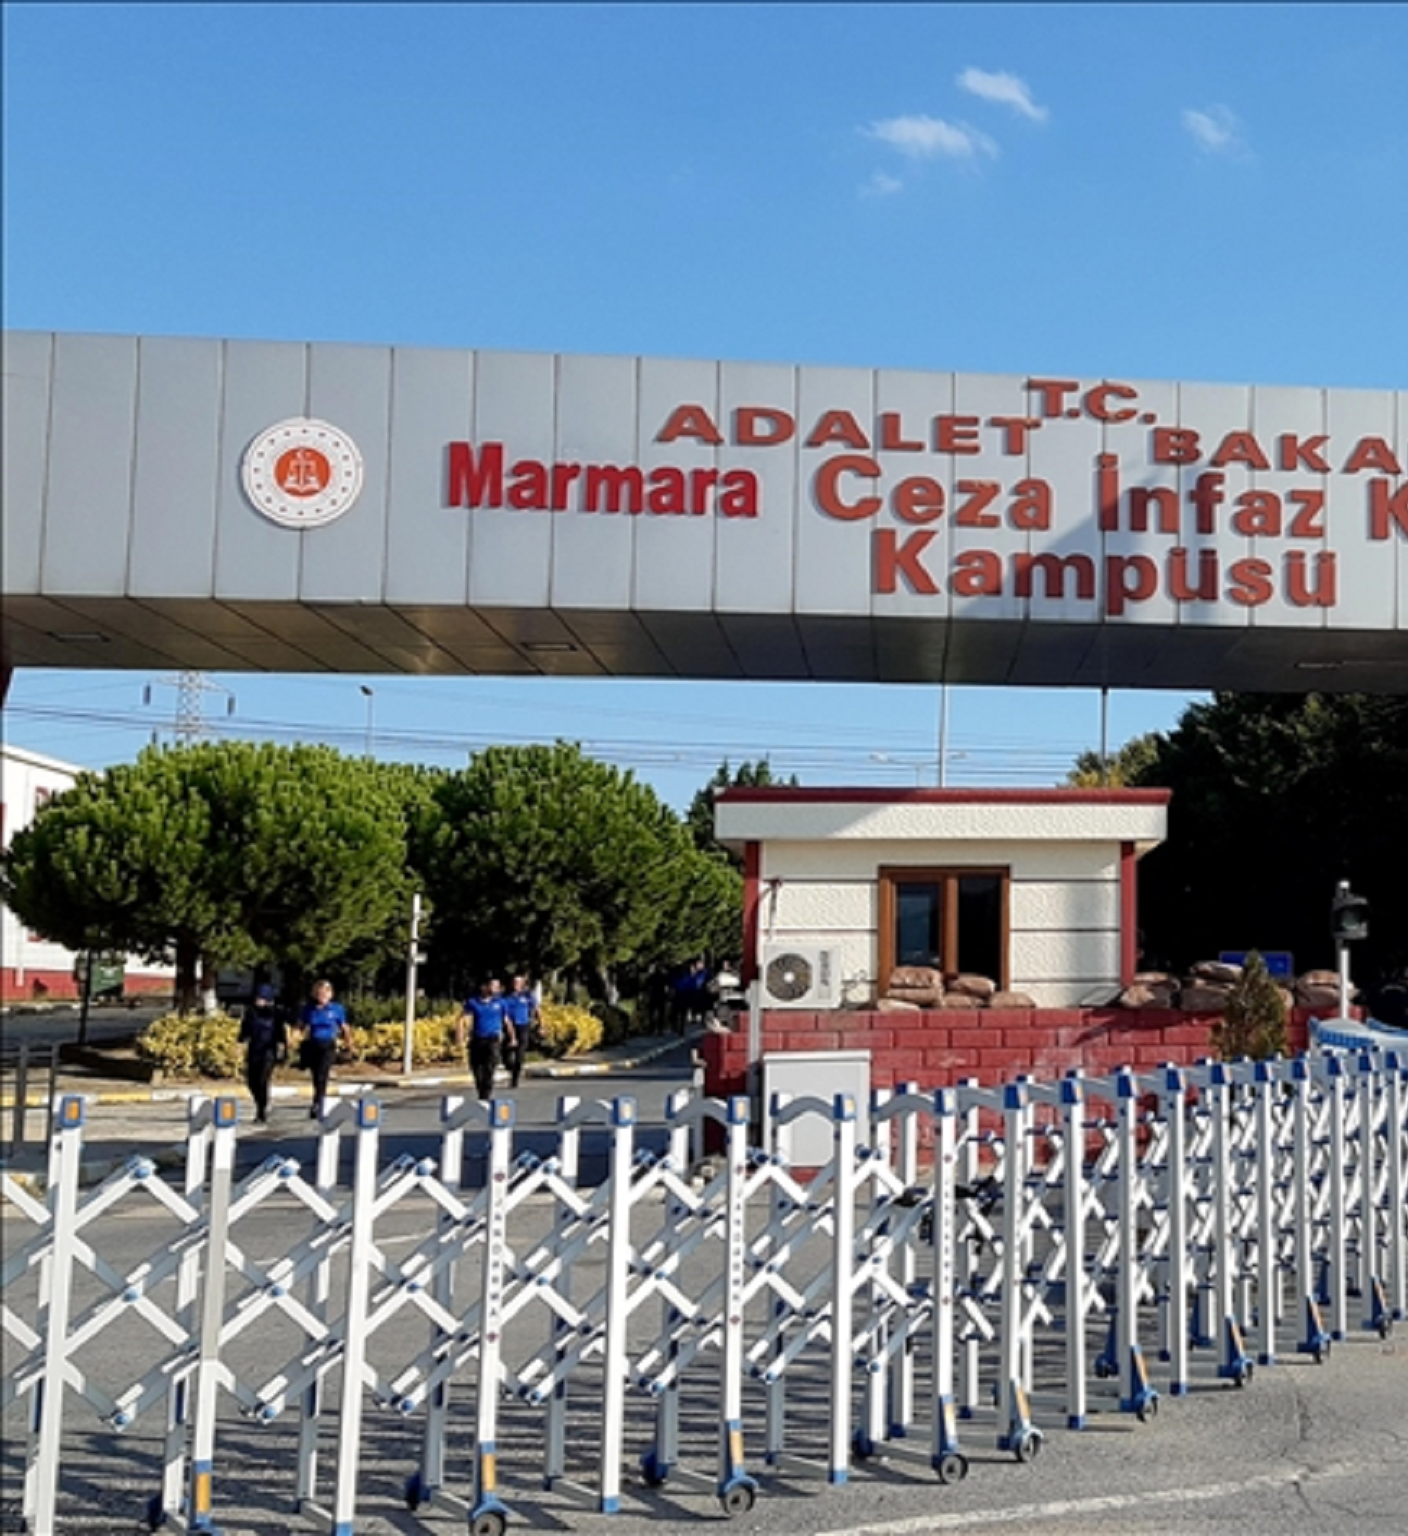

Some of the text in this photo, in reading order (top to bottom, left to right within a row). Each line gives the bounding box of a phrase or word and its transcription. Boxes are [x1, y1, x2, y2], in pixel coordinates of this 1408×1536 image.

[656, 404, 1042, 456] ADALET
[1026, 379, 1155, 423] T.C.
[447, 441, 760, 518] Marmara
[815, 455, 1053, 531] Ceza
[1098, 453, 1326, 539] İnfaz
[872, 528, 1337, 616] Kampüsü
